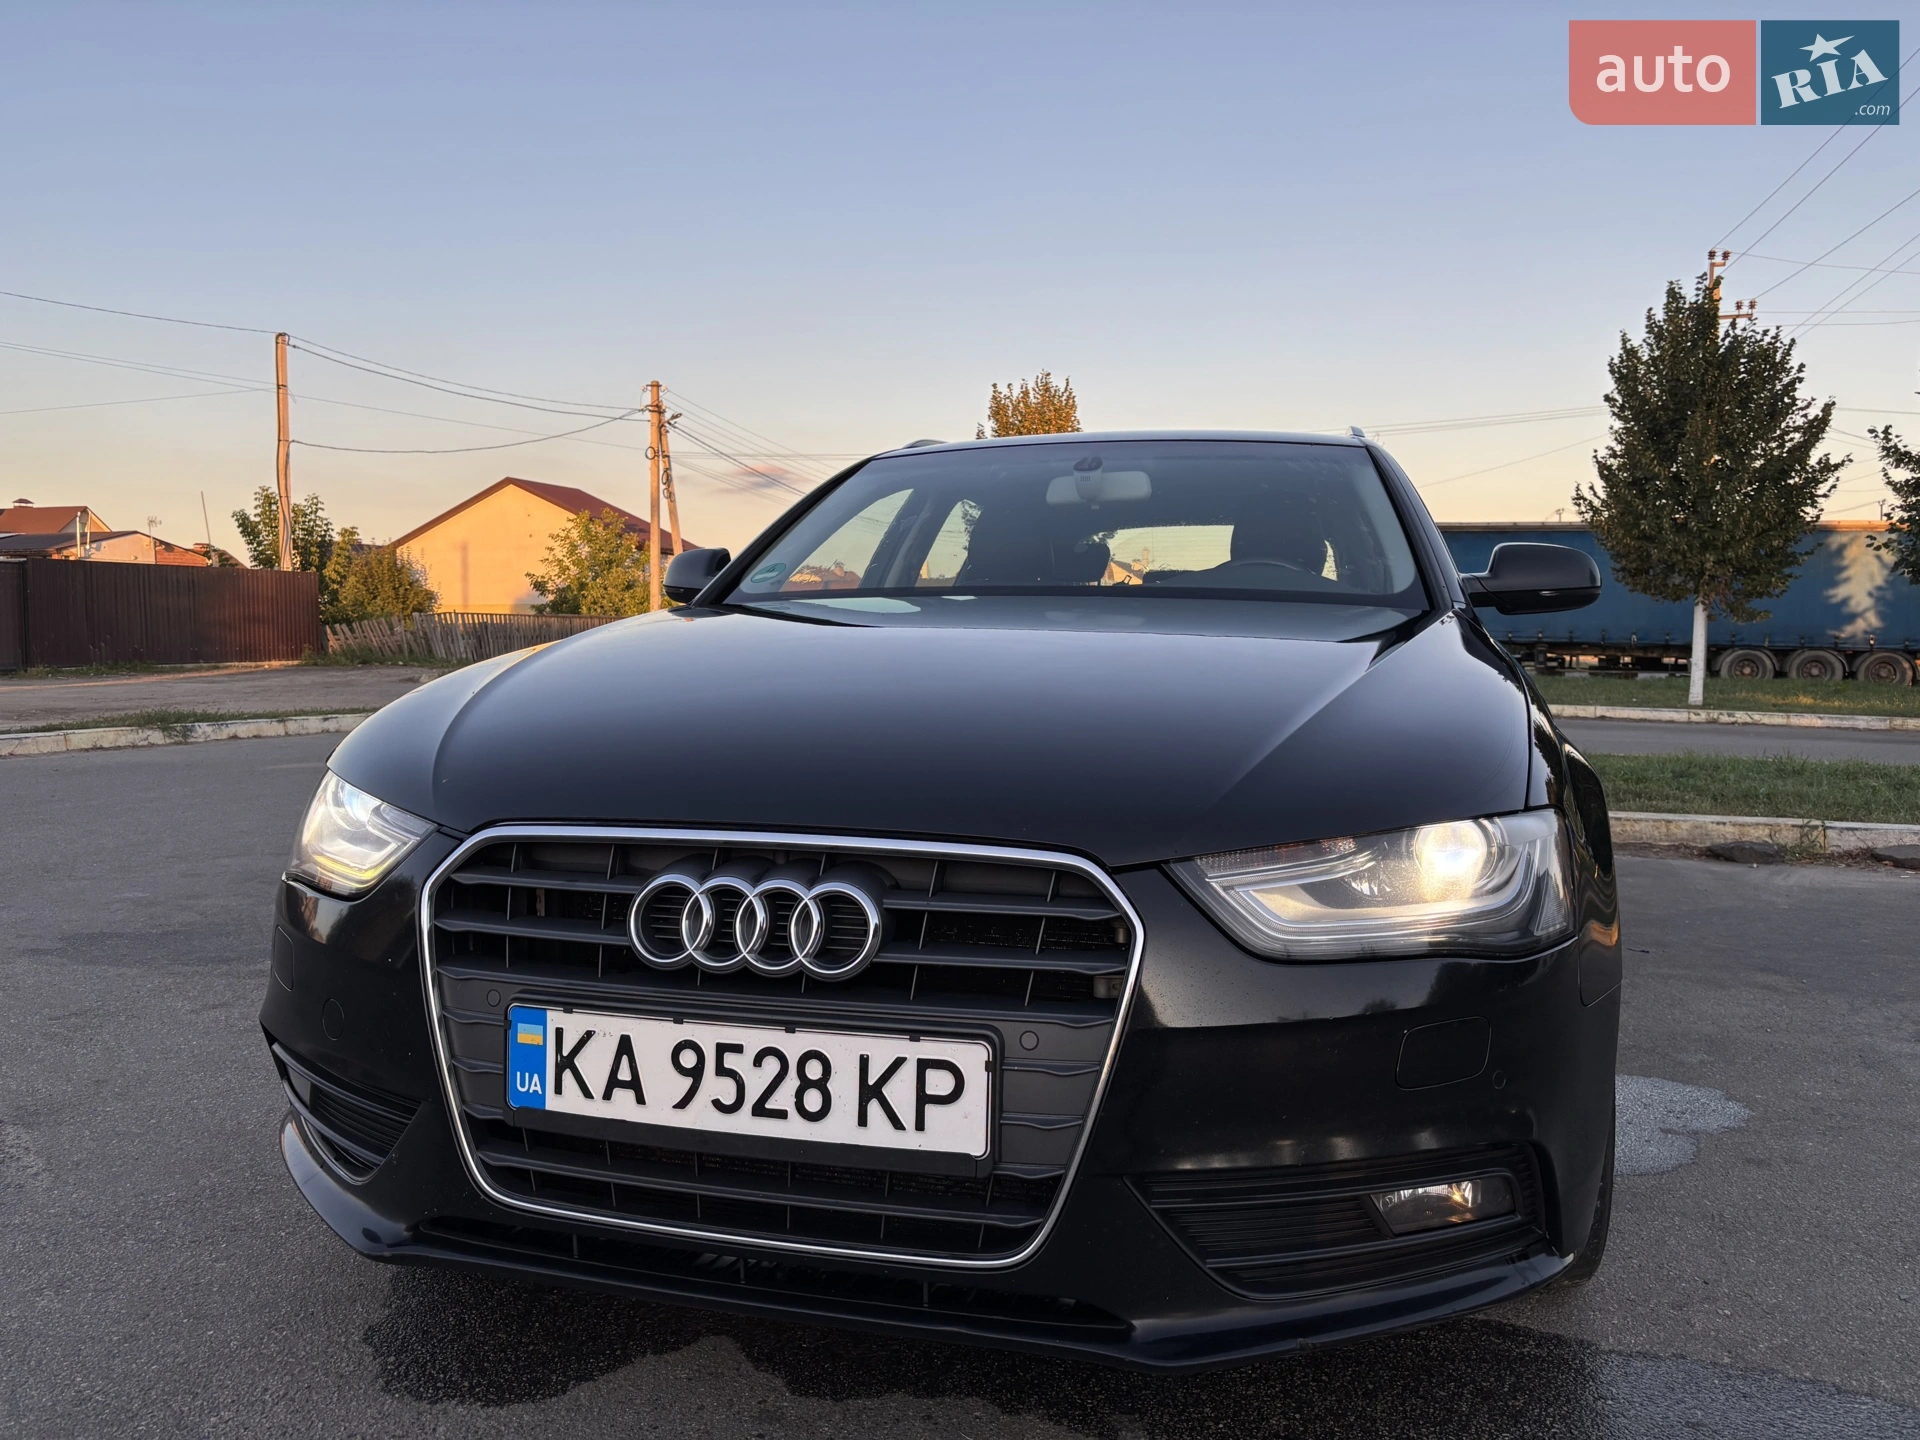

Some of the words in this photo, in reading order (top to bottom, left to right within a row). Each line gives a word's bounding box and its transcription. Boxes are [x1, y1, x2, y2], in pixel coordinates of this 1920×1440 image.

[515, 1070, 543, 1095] UA
[554, 1026, 647, 1106] KA
[670, 1038, 832, 1123] 9528
[857, 1053, 965, 1132] KP
